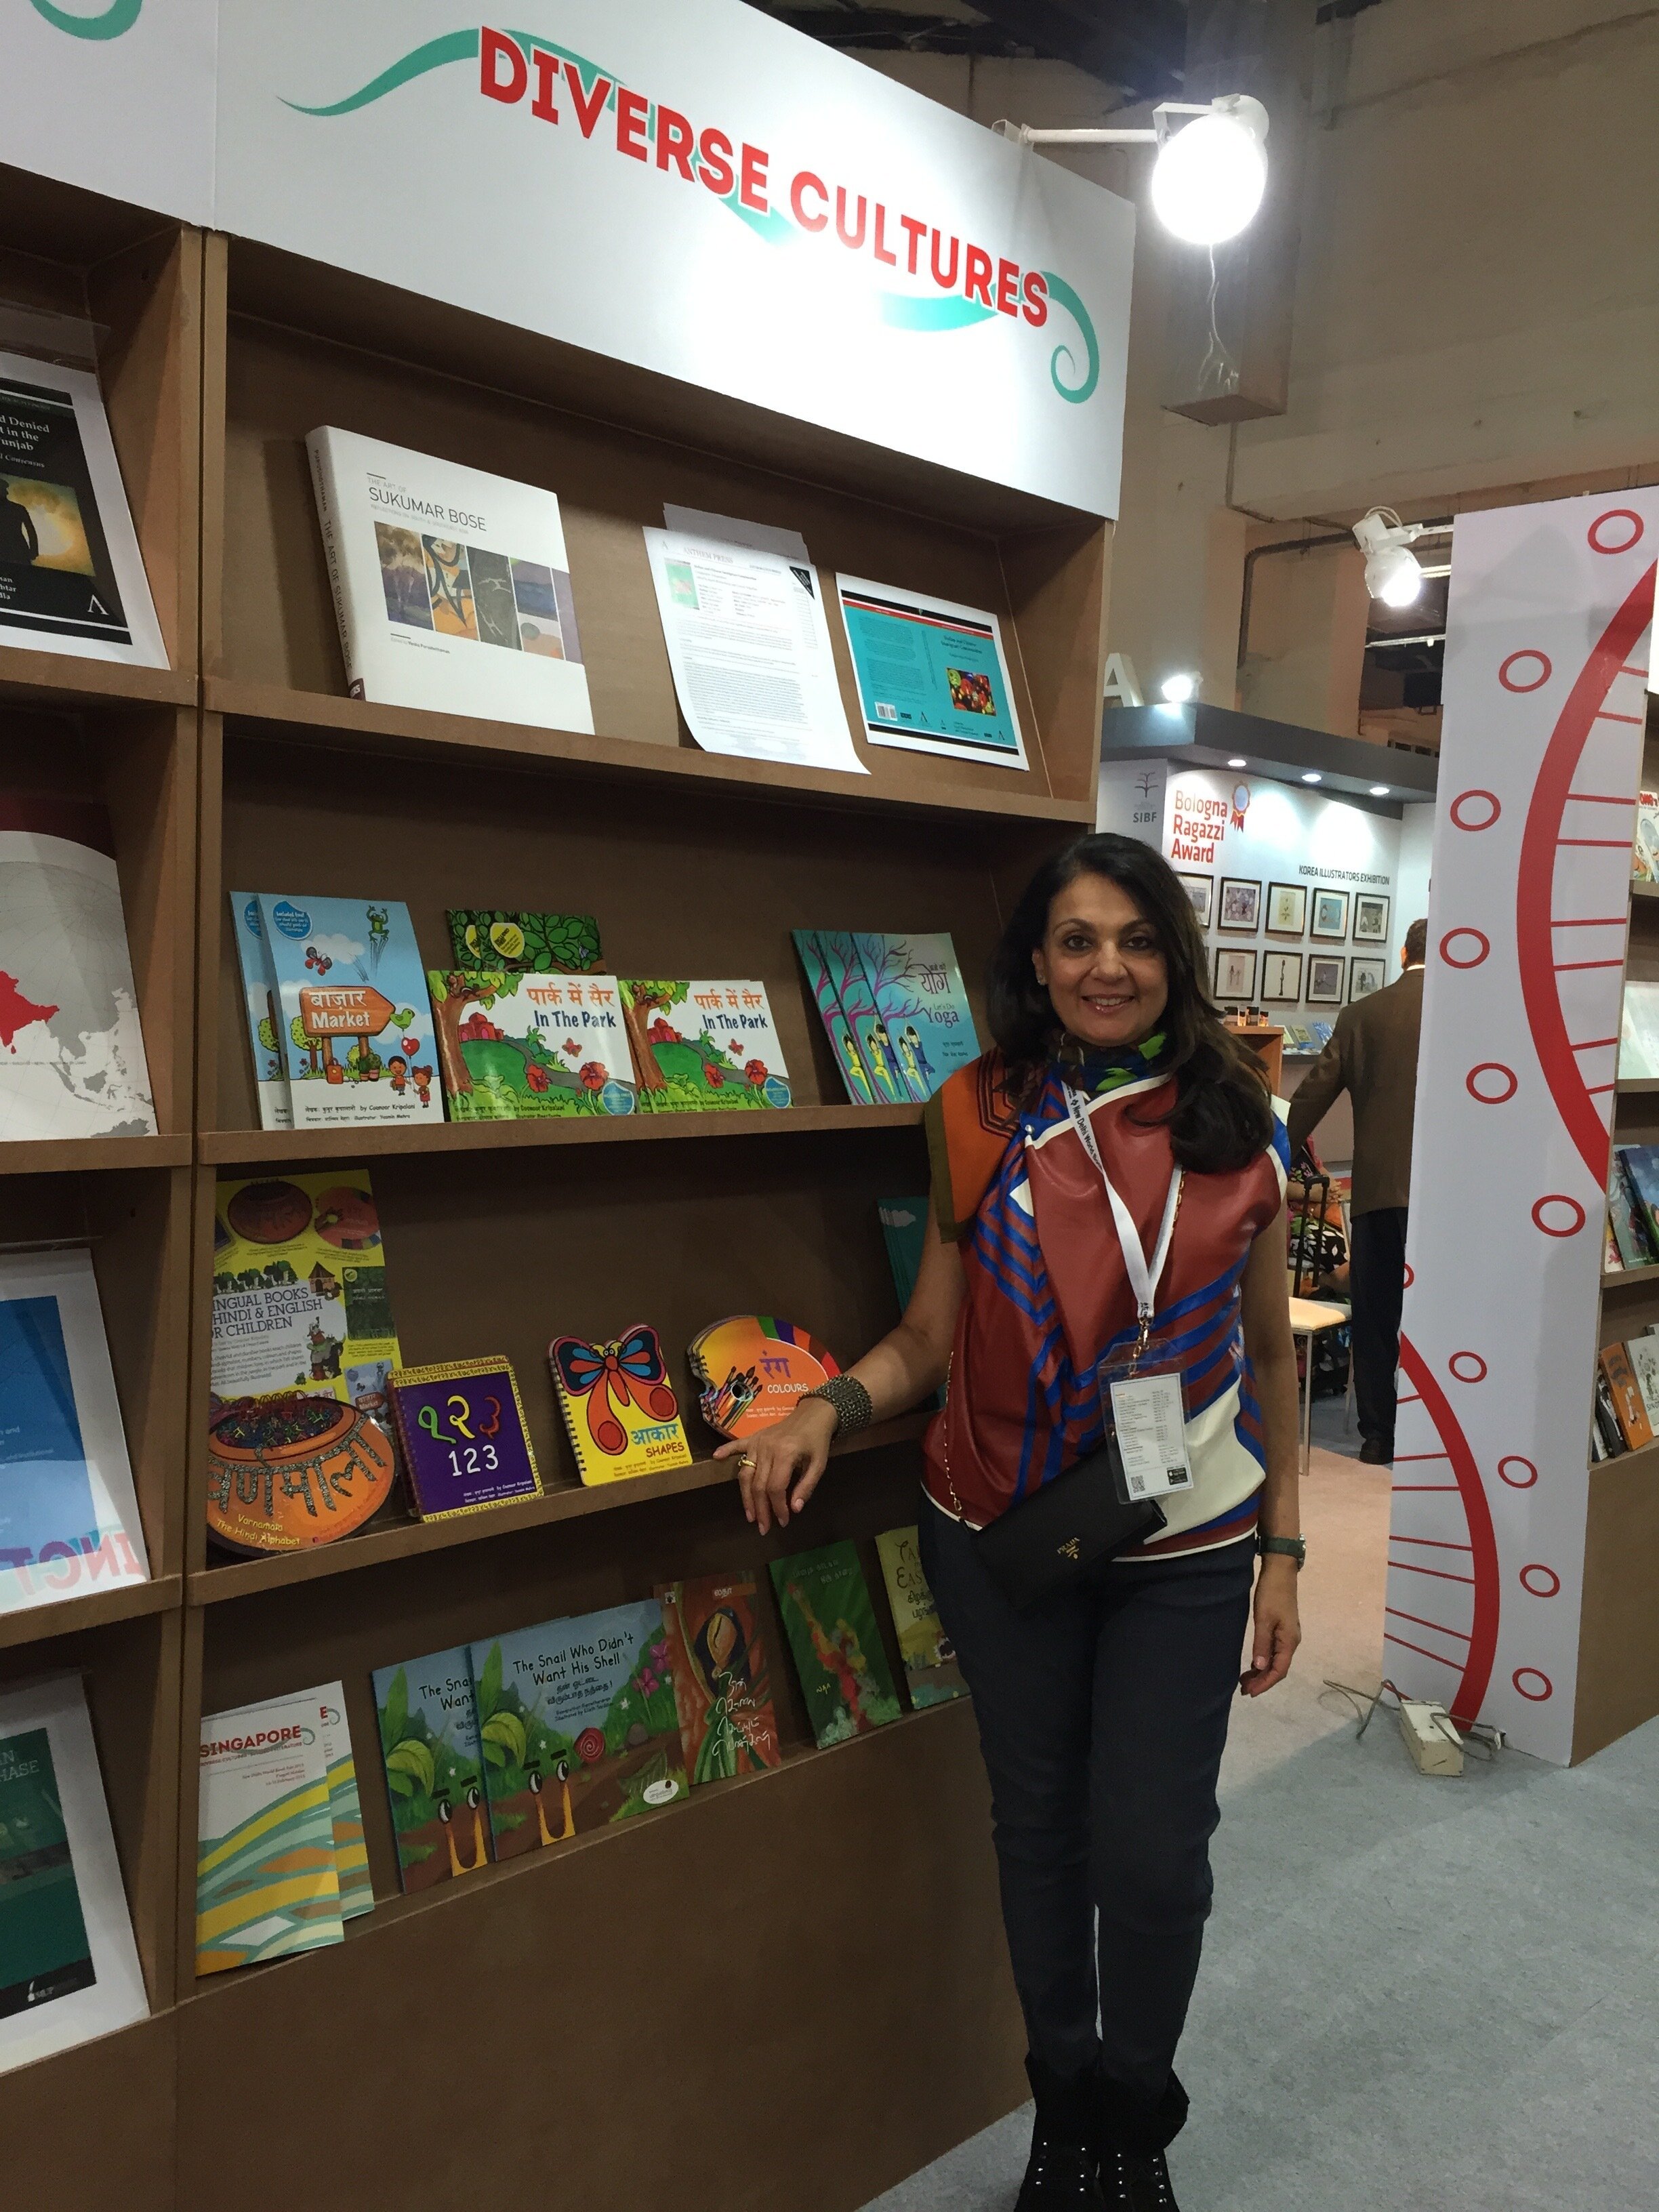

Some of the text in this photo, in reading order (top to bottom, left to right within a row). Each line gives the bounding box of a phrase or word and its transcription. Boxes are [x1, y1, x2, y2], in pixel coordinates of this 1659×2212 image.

[480, 26, 1050, 327] DIVERSE CULTURES
[6, 427, 18, 437] in
[21, 430, 39, 442] the
[9, 416, 50, 433] Denied
[0, 438, 34, 451] unjab
[367, 476, 381, 486] THE
[369, 487, 487, 532] SUKUMAR BOSE
[323, 520, 334, 541] THE
[328, 543, 337, 567] ART
[1174, 790, 1228, 821] Bologna
[1132, 811, 1158, 823] SIBF
[1173, 813, 1225, 843] Ragazzi
[1170, 838, 1215, 864] Award
[1298, 864, 1391, 886] KOREA ILLUSTRATORS EXHIBITION
[918, 970, 951, 994] योग
[308, 990, 367, 1010] बाज़ार
[526, 982, 615, 1007] पार्क में सैर
[693, 988, 764, 1010] पार्क में सैर
[311, 1010, 370, 1029] Market
[533, 1010, 617, 1029] In The Park
[702, 1014, 769, 1029] In The Park
[924, 1006, 960, 1029] Yoga
[392, 1103, 416, 1111] Kripalani
[1072, 1105, 1082, 1119] New
[1076, 1118, 1088, 1136] Delhi
[213, 1288, 309, 1312] INGUAL BOOKS
[213, 1298, 323, 1326] HINDI & ENGLISH
[226, 1316, 293, 1337] CHILDREN
[758, 1349, 792, 1380] रंग
[766, 1382, 809, 1394] COLOURS
[630, 1422, 679, 1446] आकार
[448, 1444, 499, 1477] 123
[645, 1441, 685, 1458] SHAPES
[217, 1519, 301, 1546] The Hindi Alphabet
[237, 1513, 284, 1532] Varnamala
[896, 1566, 922, 1589] EAS
[512, 1631, 634, 1675] The Snail Who Didn't
[533, 1652, 620, 1687] Want His Shell
[418, 1676, 473, 1700] The Snai
[440, 1689, 474, 1711] Want
[199, 1725, 302, 1759] SINGAPORE
